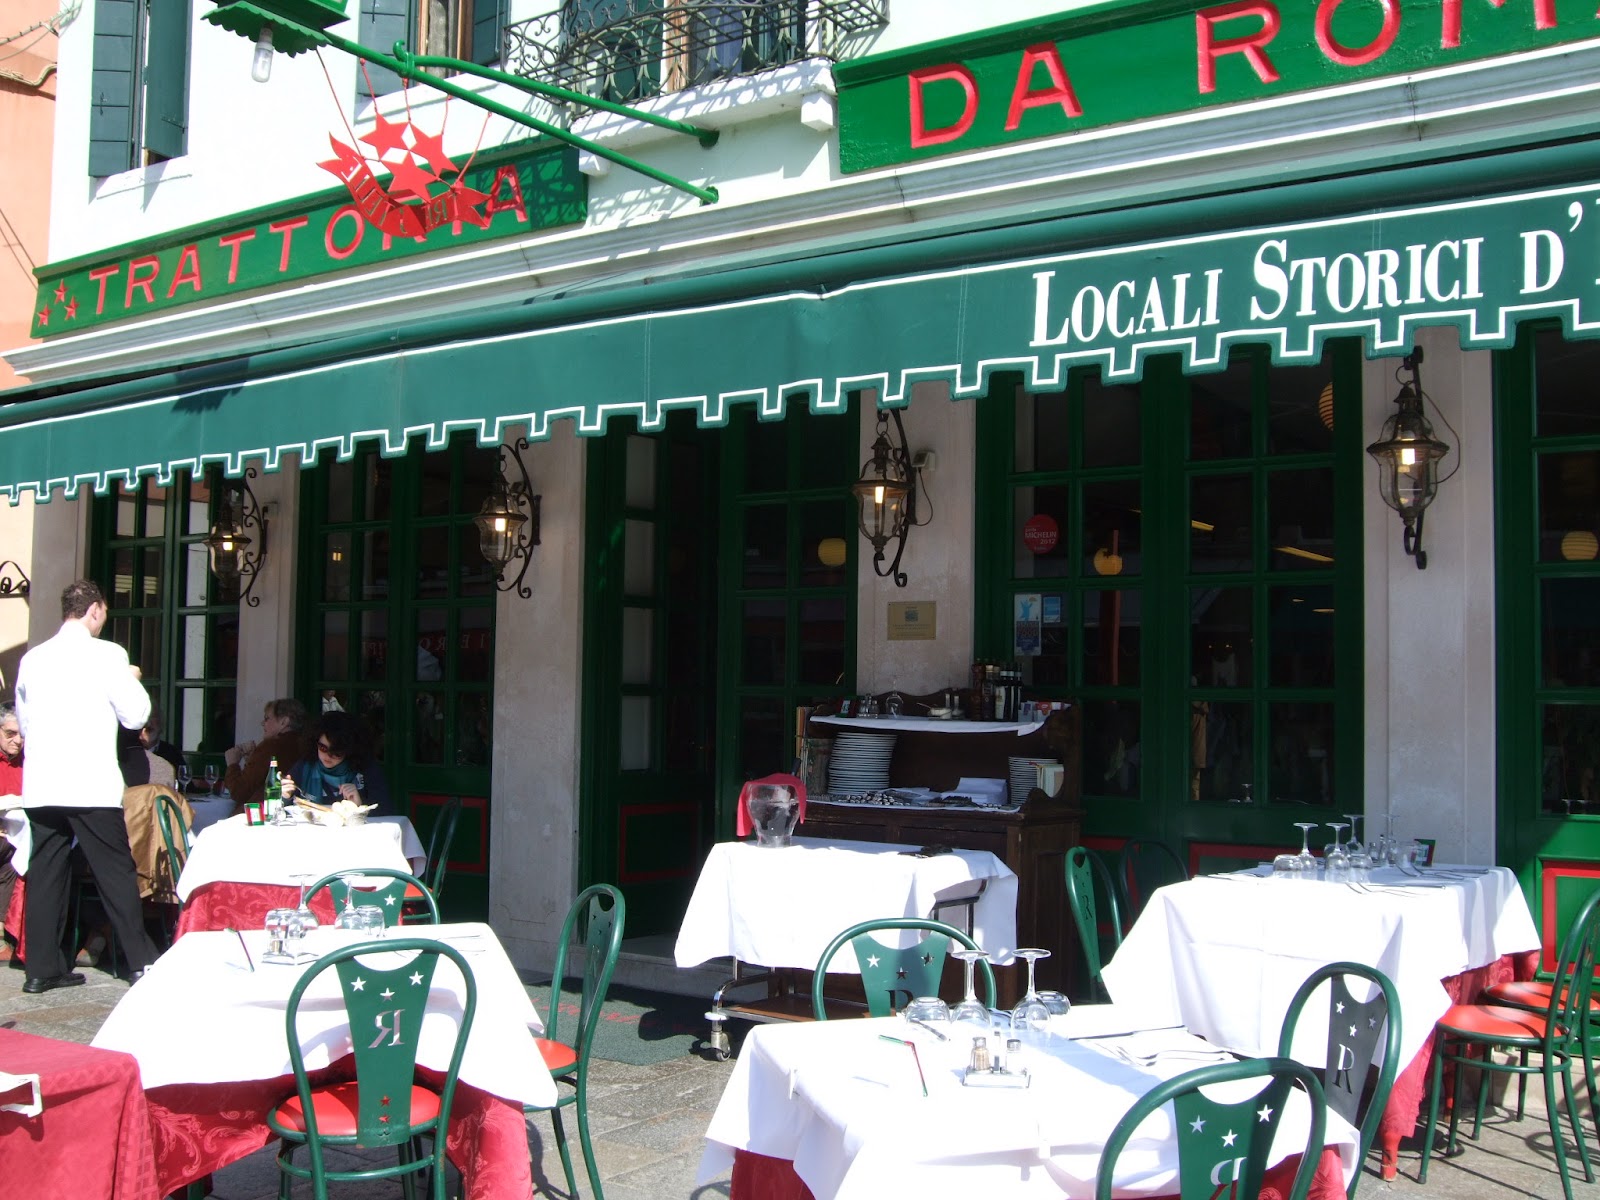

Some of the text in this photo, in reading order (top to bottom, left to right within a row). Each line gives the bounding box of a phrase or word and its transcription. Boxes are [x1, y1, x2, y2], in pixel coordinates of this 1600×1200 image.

[908, 40, 1084, 148] DA
[88, 165, 528, 315] TRATTOA
[1029, 198, 1600, 347] LOCALI STORICI D'
[1024, 531, 1057, 539] MICHELIN
[1332, 1043, 1355, 1095] R
